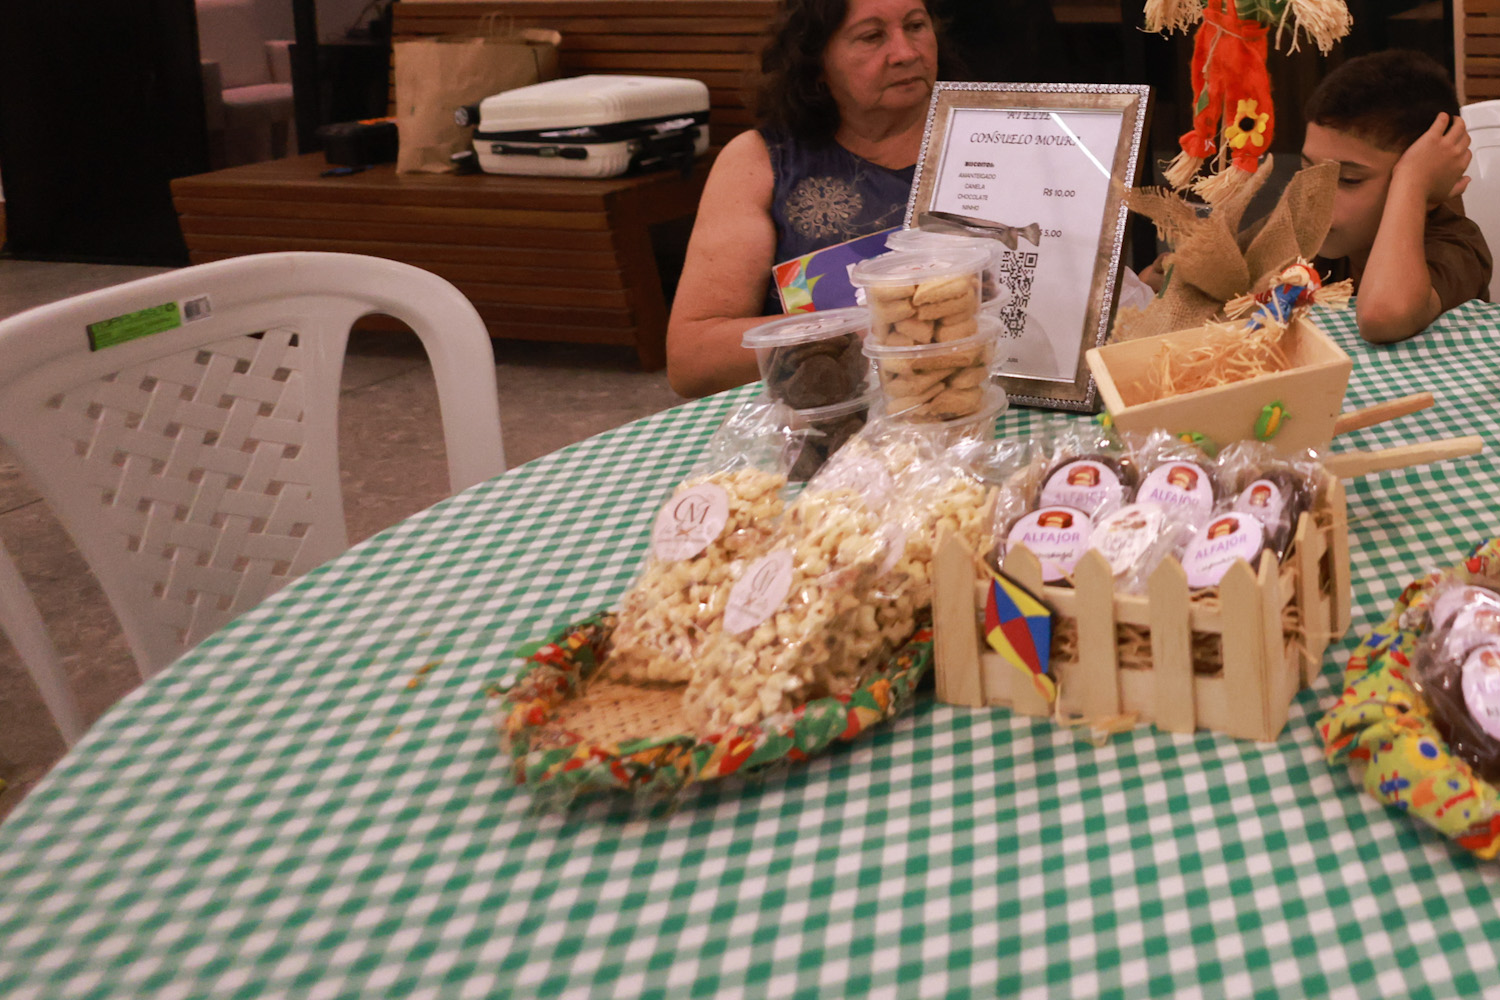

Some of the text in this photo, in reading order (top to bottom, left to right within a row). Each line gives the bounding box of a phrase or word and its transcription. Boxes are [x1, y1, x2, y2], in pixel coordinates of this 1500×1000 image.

[970, 131, 1032, 145] CONSUELO
[1043, 188, 1053, 196] R$
[1022, 531, 1081, 544] ALFAJOR
[1195, 533, 1247, 560] ALFAJOR
